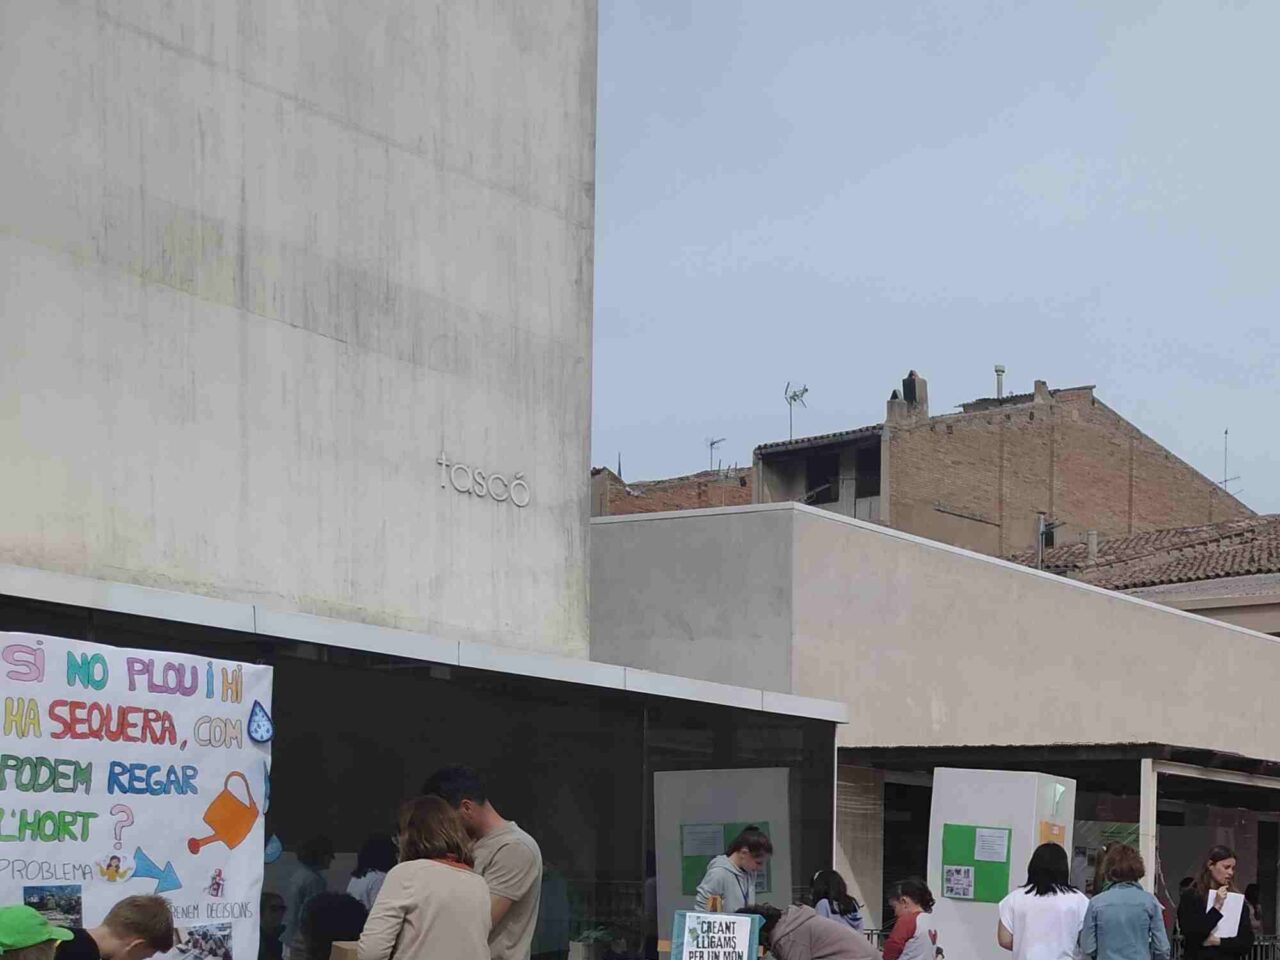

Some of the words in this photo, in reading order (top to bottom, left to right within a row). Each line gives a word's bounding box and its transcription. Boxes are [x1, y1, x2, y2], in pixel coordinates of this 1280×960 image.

[67, 650, 109, 690] NO
[126, 656, 199, 696] PLOU
[3, 696, 42, 737] HA
[193, 715, 243, 748] COM
[0, 754, 92, 795] PODEM
[107, 761, 199, 795] REGAR
[206, 902, 253, 919] DECISIONS
